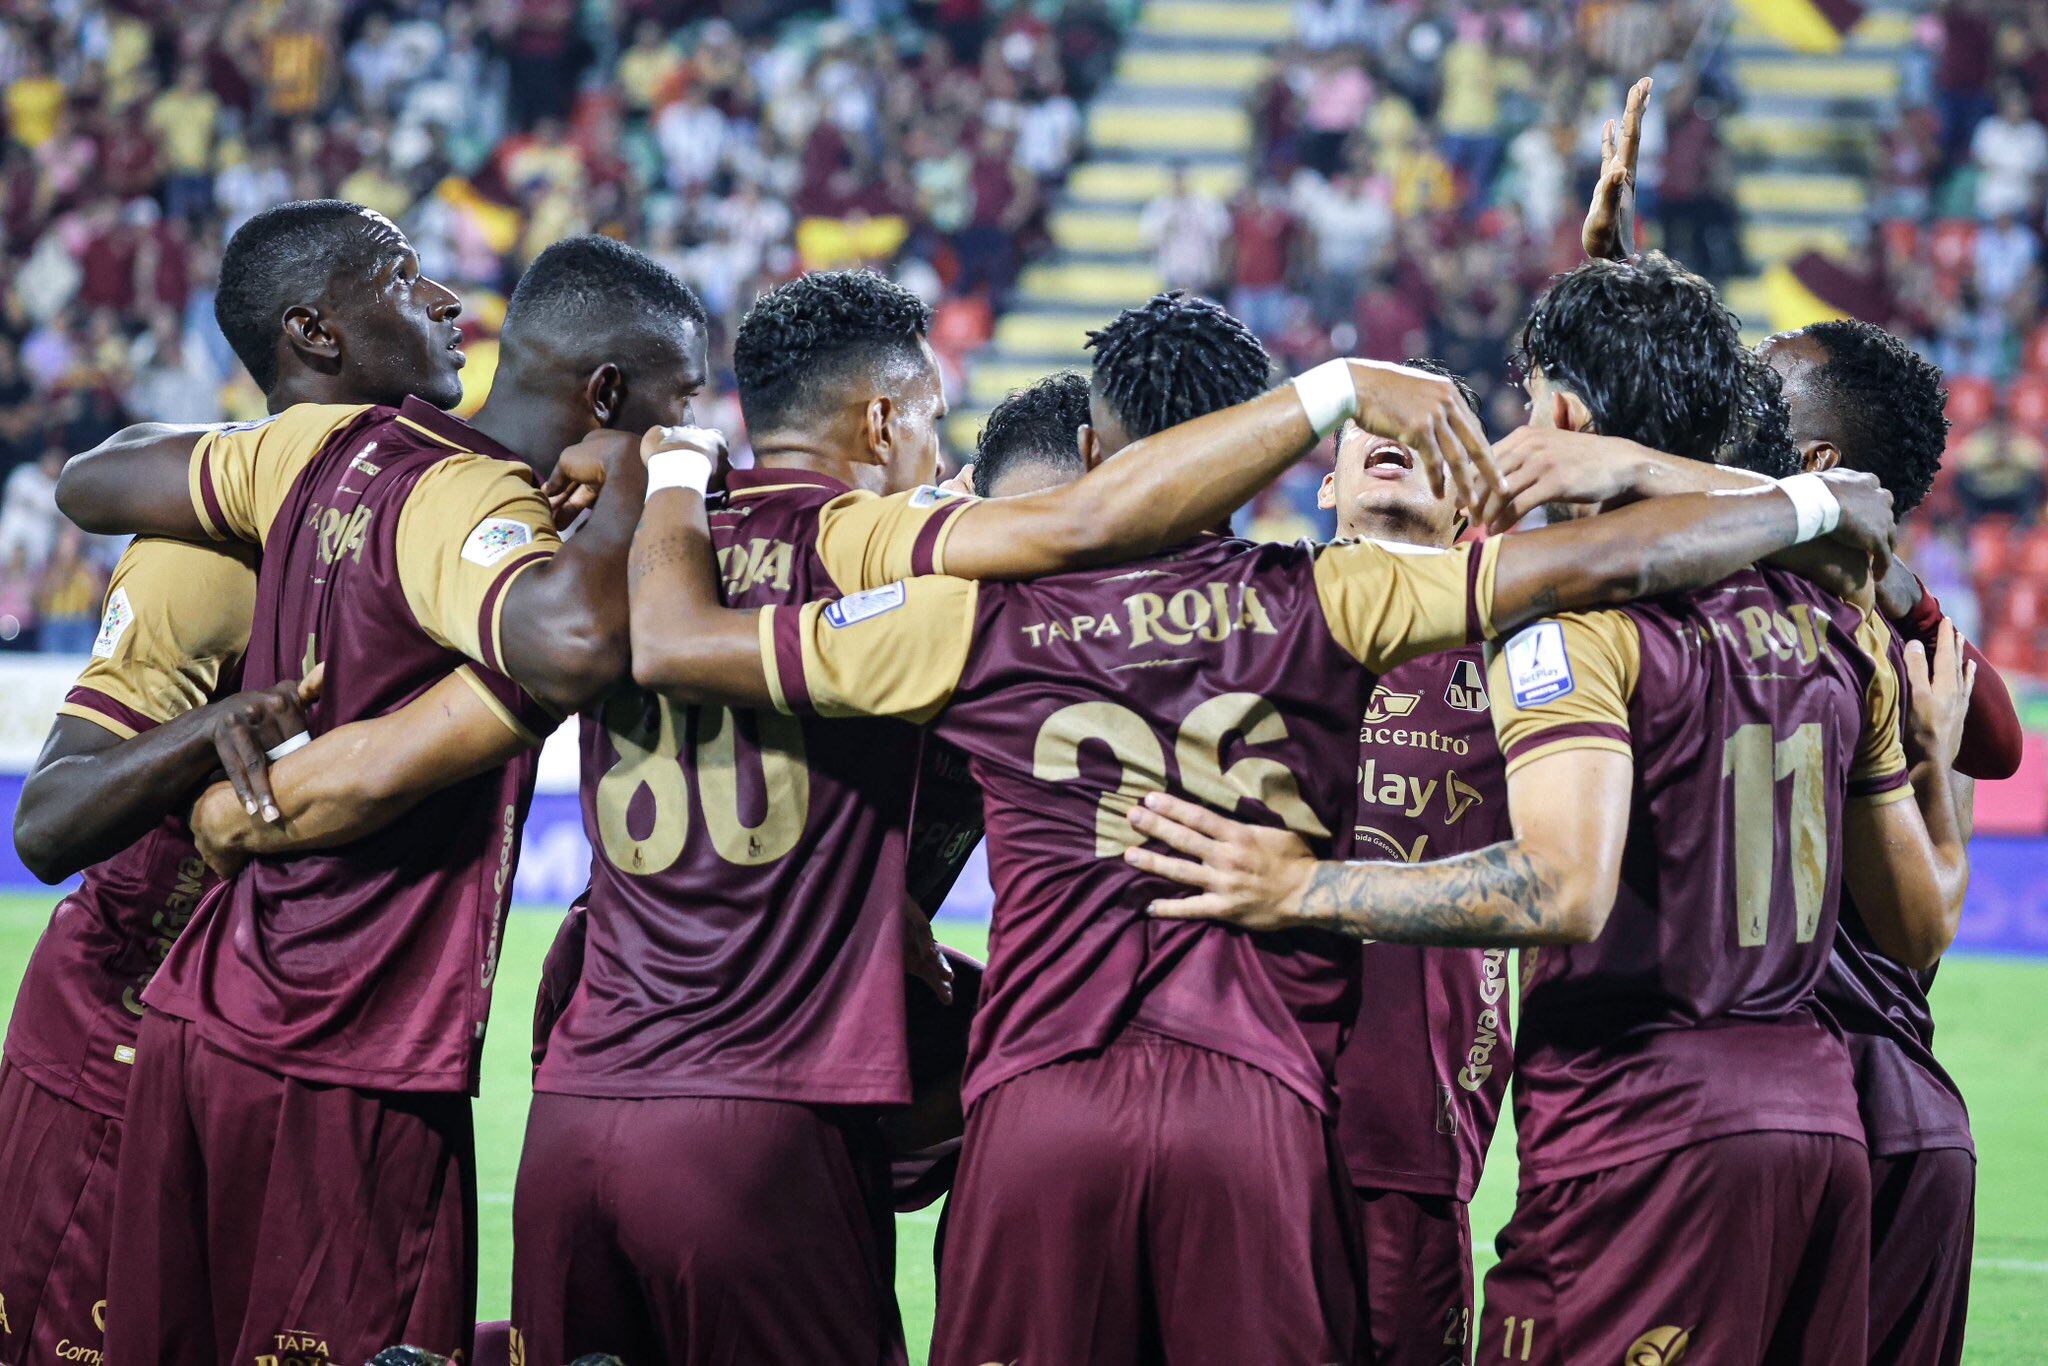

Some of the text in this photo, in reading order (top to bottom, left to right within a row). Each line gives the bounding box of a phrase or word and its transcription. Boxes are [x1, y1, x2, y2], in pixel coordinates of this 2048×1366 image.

[717, 537, 794, 595] OJA
[1021, 582, 1279, 651] TAPA ROJA
[1359, 726, 1470, 756] acentro
[597, 693, 809, 876] 80
[1033, 692, 1332, 858] 26
[1357, 758, 1438, 818] lay
[1355, 833, 1399, 860] bida Gaseosa
[1722, 723, 1828, 948] 11
[274, 1334, 330, 1357] TAPA
[1503, 1315, 1536, 1362] 11
